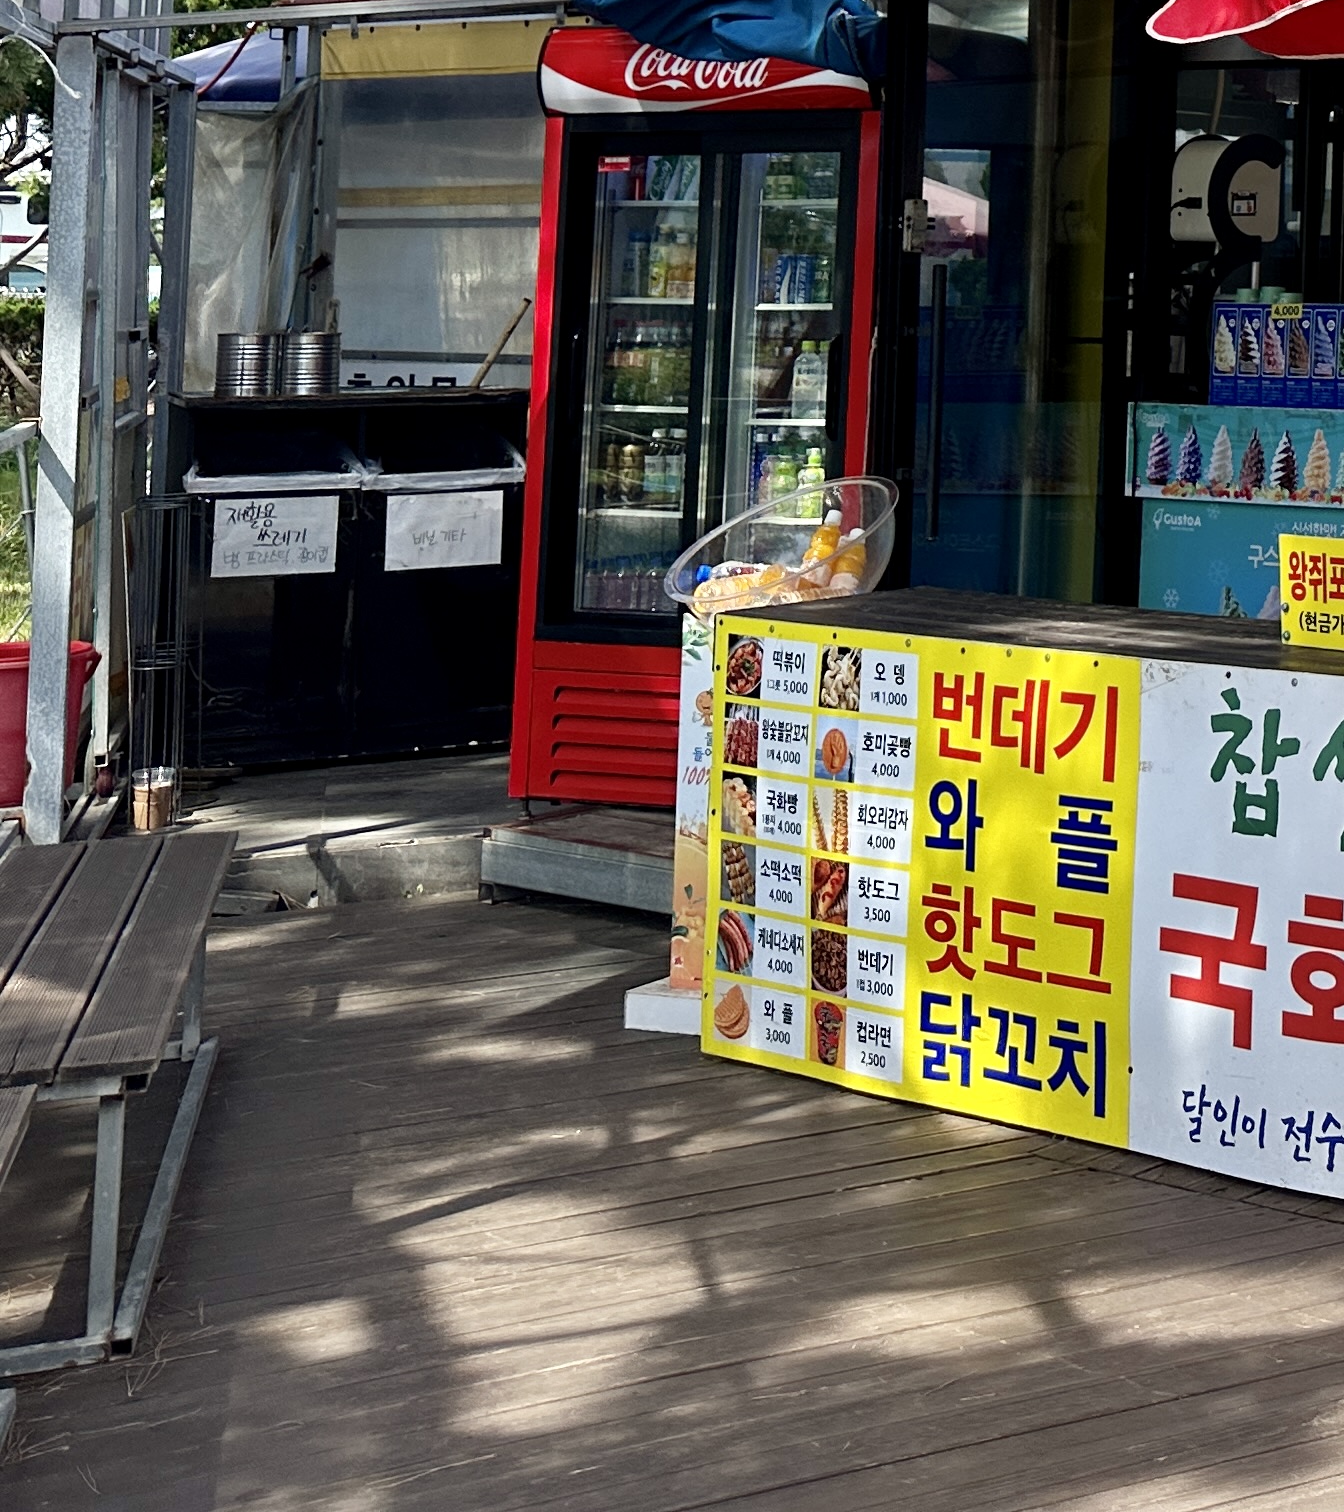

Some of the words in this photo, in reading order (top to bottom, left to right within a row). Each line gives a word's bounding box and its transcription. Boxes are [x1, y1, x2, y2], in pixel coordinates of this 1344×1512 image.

[1273, 305, 1300, 317] 4,000
[1164, 512, 1202, 528] GustoA
[772, 649, 806, 675] 떡볶이
[783, 679, 809, 695] 5,000
[881, 691, 908, 707] 1,000
[932, 671, 1119, 783] 번데기
[861, 731, 913, 759] 호미곶빵
[775, 749, 801, 765] 4,000
[871, 763, 900, 778] 4,000
[765, 789, 799, 815] 국화빵
[857, 805, 909, 831] 회오리감자
[777, 821, 802, 836] 4,000
[867, 835, 896, 850] 4,000
[760, 858, 802, 887] 소떡소떡
[768, 889, 793, 904] 4,000
[857, 876, 900, 901] 핫도그
[864, 906, 891, 923] 3,500
[922, 882, 1112, 995] 핫도그
[767, 957, 793, 974] 4,000
[857, 948, 894, 976] 번데기
[867, 979, 894, 997] 3,000
[765, 1028, 791, 1045] 3,000
[856, 1020, 892, 1049] 컵라면
[860, 1050, 886, 1069] 2,500
[919, 990, 1107, 1119] 닭꼬치
[1181, 1085, 1267, 1150] 달인이
